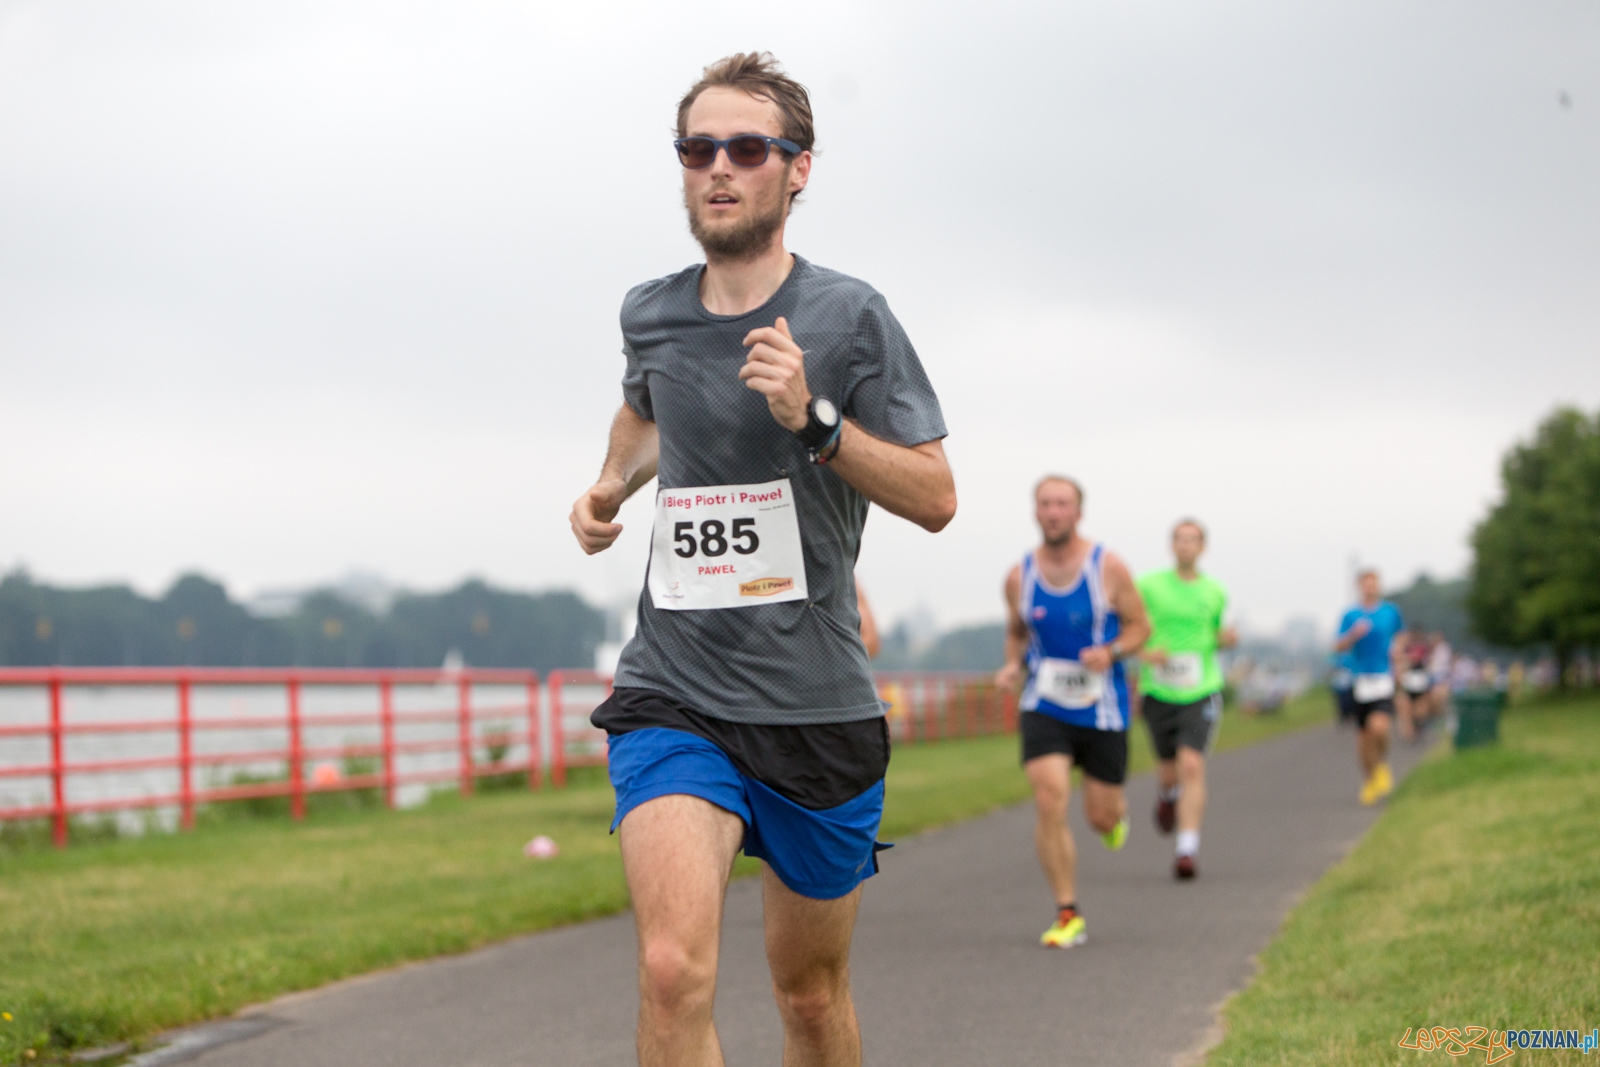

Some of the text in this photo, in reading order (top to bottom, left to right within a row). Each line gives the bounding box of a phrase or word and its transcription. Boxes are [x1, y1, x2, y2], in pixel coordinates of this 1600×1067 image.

[667, 496, 691, 509] Bieg
[695, 494, 727, 506] Piotr
[731, 493, 735, 504] i
[739, 488, 783, 503] Paweł
[674, 517, 760, 559] 585
[698, 564, 737, 575] PAWEŁ
